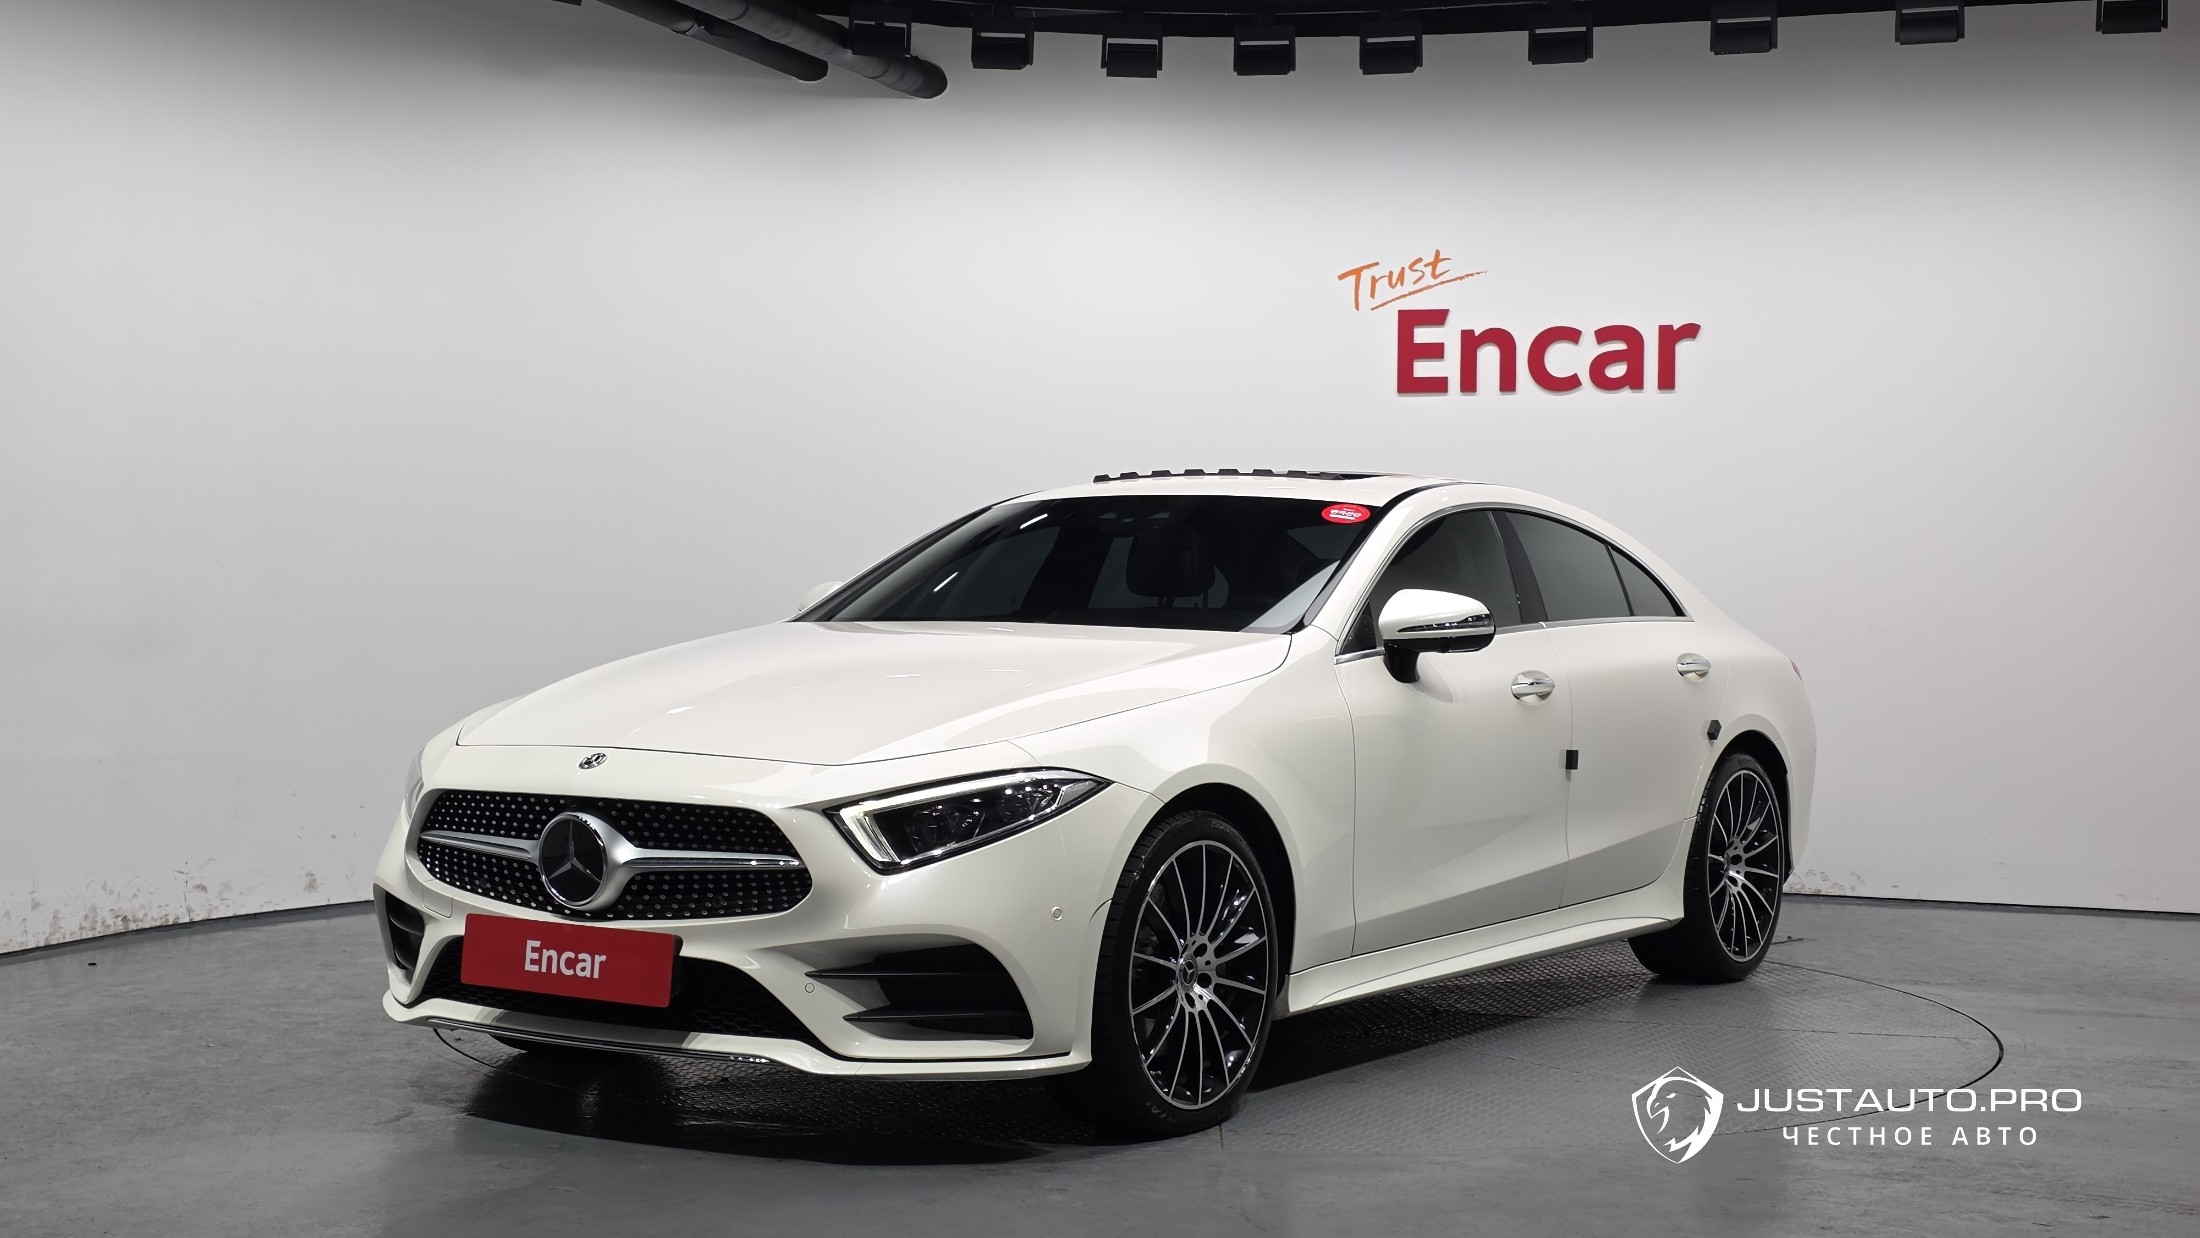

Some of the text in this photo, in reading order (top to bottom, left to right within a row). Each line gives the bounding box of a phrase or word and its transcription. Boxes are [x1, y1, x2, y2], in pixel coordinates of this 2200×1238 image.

[1338, 249, 1454, 311] Trust
[1396, 308, 1702, 394] Encar
[524, 940, 607, 979] Encar
